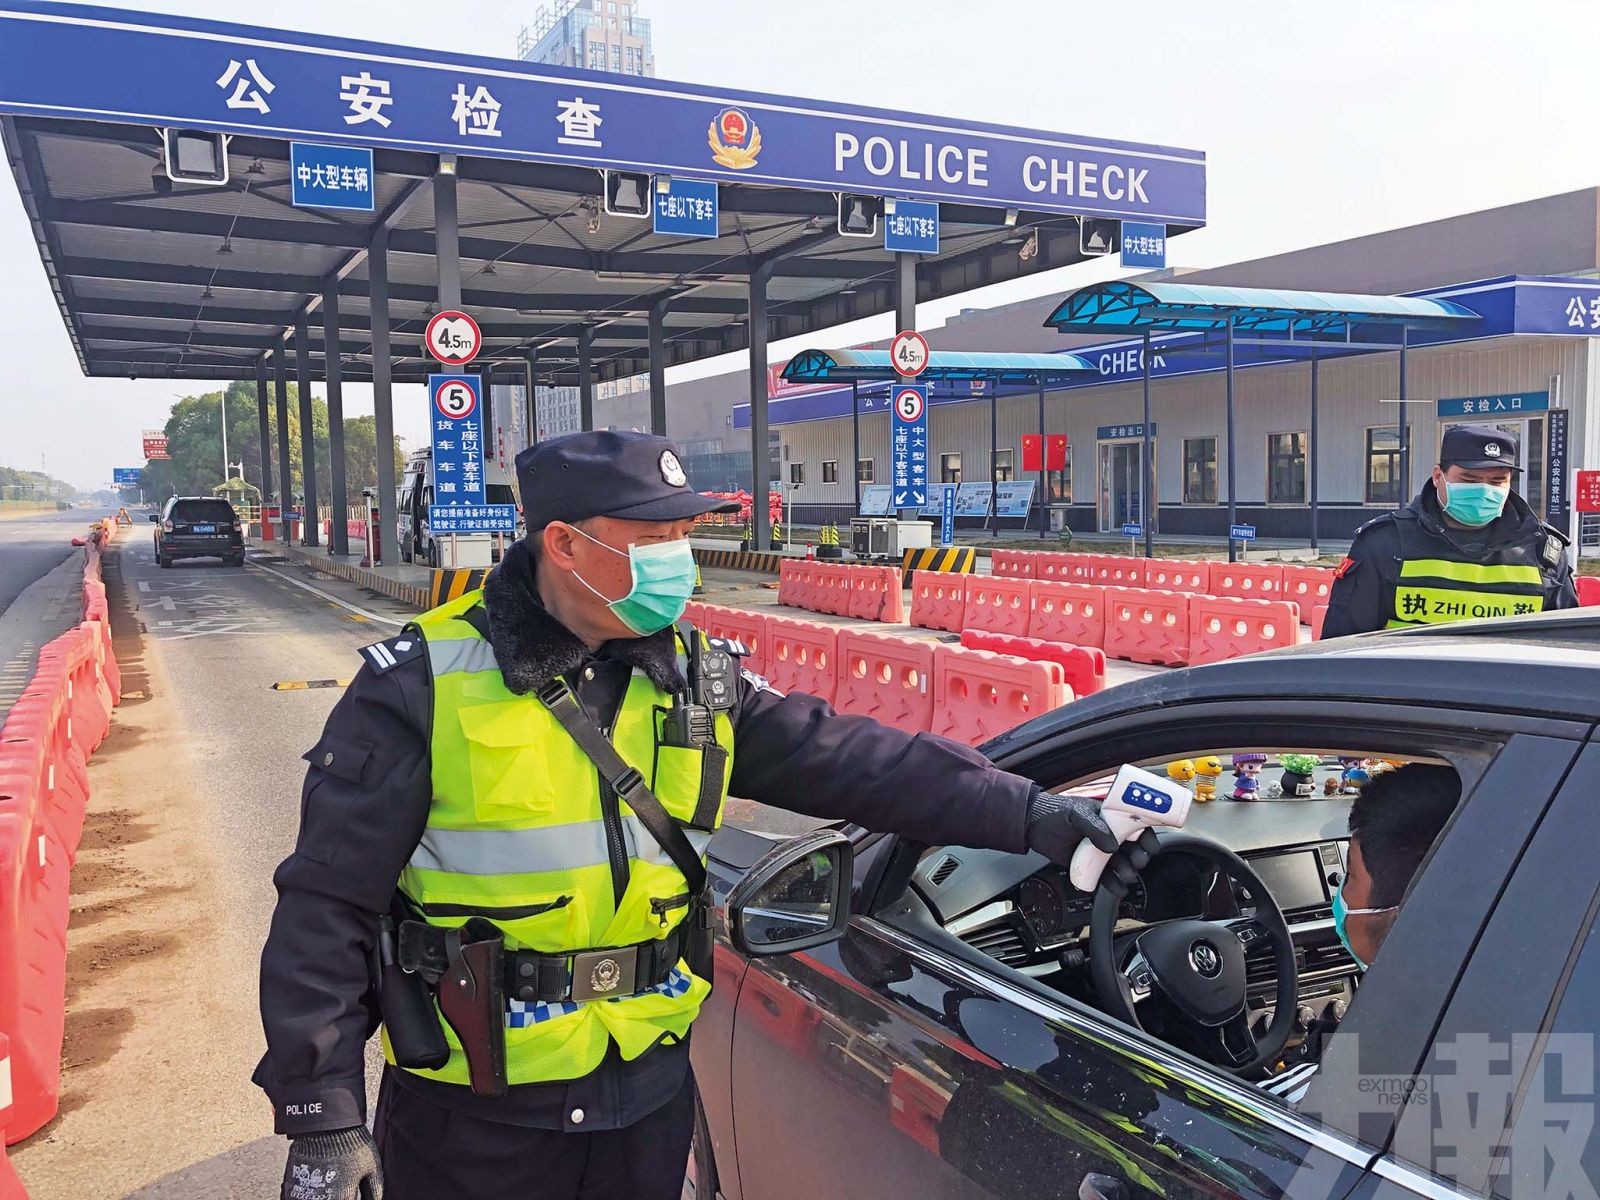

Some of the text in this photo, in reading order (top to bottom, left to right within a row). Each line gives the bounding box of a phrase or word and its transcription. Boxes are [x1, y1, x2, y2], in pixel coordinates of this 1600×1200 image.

[216, 58, 603, 149] 公安检查
[297, 162, 370, 193] 中大型车辆
[834, 132, 1150, 205] POLICE CHECK
[658, 195, 714, 220] 七座以下客车
[888, 215, 935, 239] 七座以下客车
[1124, 234, 1164, 257] 中大型车辆
[438, 328, 472, 349] 4.5m
[898, 345, 923, 362] 4.5m
[449, 389, 464, 410] 5
[904, 397, 915, 415] 5
[1463, 398, 1522, 413] 安检入口
[1110, 426, 1143, 437] 安检出口
[436, 420, 457, 493] 货车车道
[461, 420, 481, 493] 七座以下客车道
[895, 426, 908, 487] 七座以下客车道
[912, 426, 925, 486] 中大型客车
[1551, 458, 1561, 504] 公安检查站
[1402, 593, 1428, 616] 执
[1434, 601, 1466, 616] ZHI
[1472, 604, 1507, 618] QIN
[286, 1102, 323, 1116] POLICE
